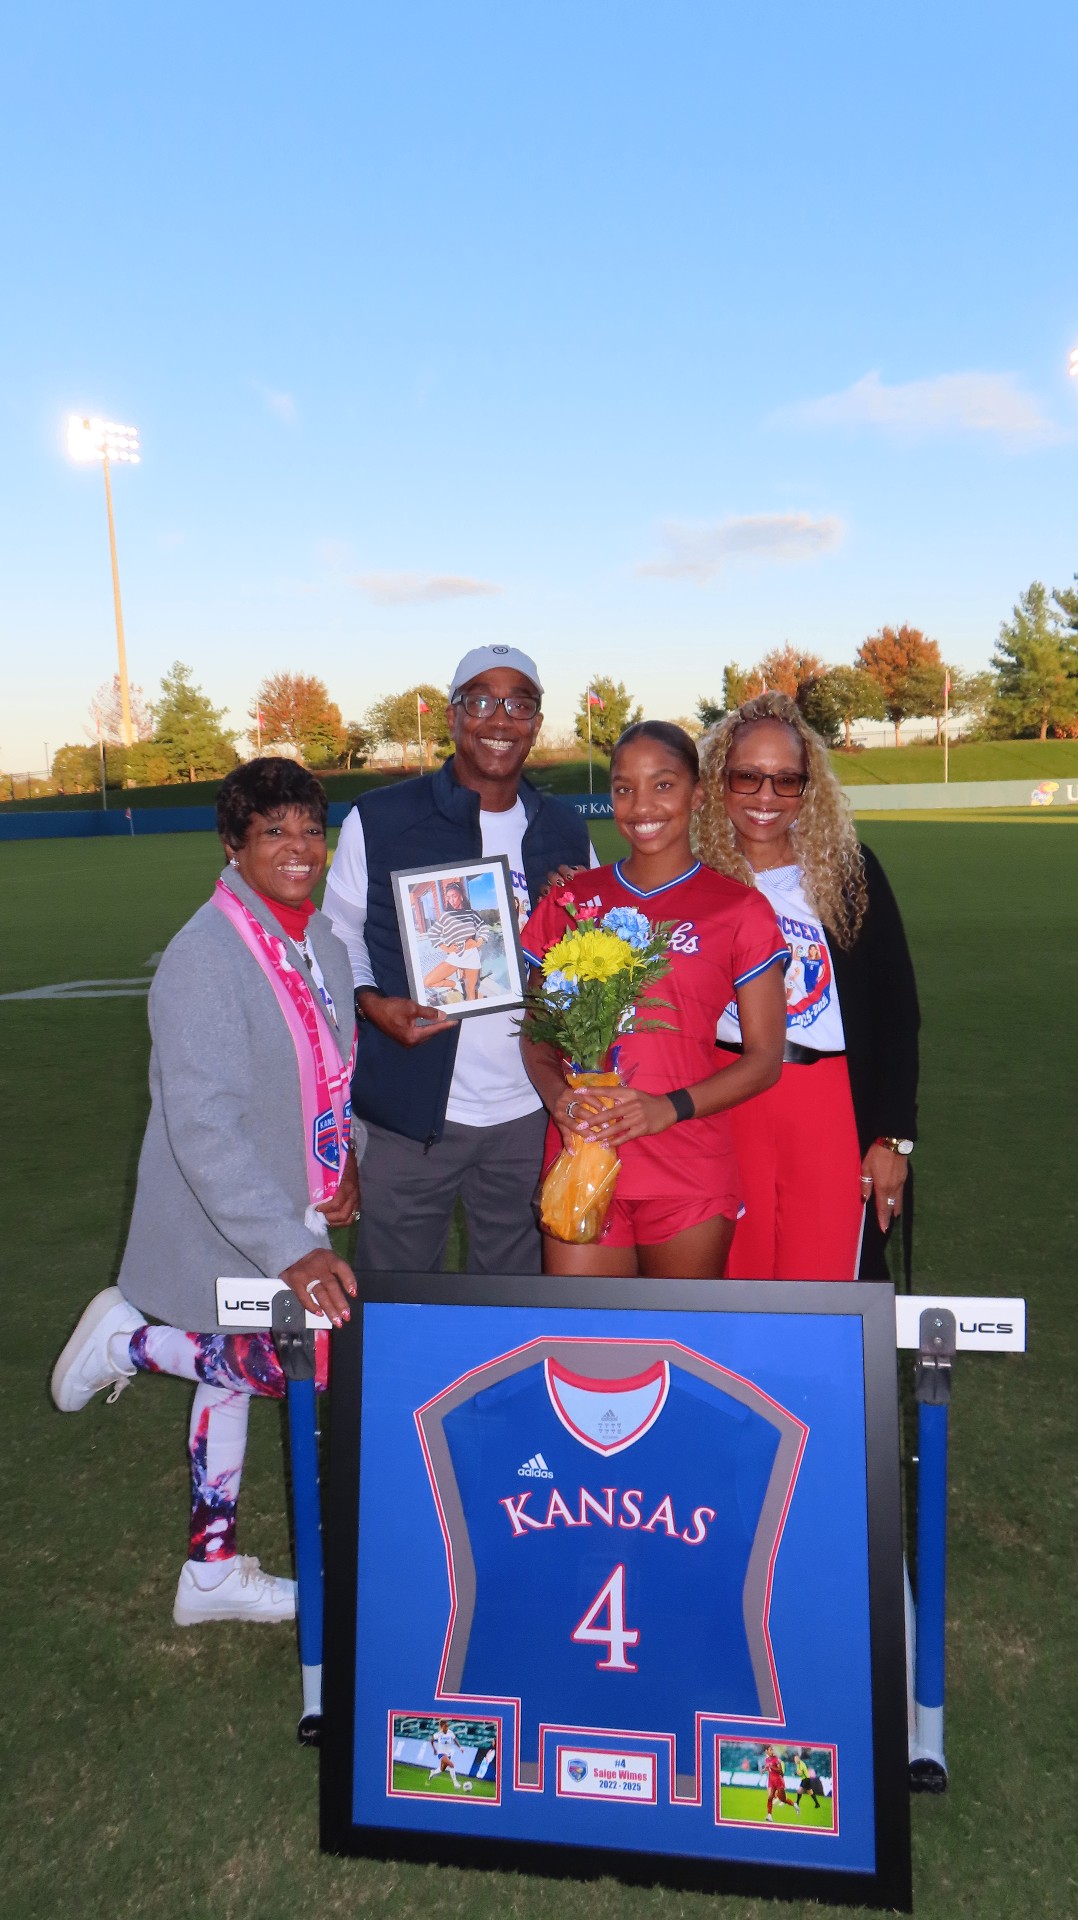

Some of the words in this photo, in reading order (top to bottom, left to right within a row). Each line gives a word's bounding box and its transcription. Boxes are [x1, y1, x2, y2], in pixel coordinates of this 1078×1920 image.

[225, 1300, 270, 1311] UCS
[959, 1322, 1014, 1334] UCS
[517, 1467, 554, 1479] adidas
[499, 1486, 717, 1545] KANSAS
[570, 1562, 641, 1673] 4
[615, 1759, 626, 1768] #4
[593, 1768, 617, 1780] Saige
[618, 1770, 648, 1782] Wimes
[599, 1780, 617, 1789] 2022
[623, 1782, 641, 1791] 2025
